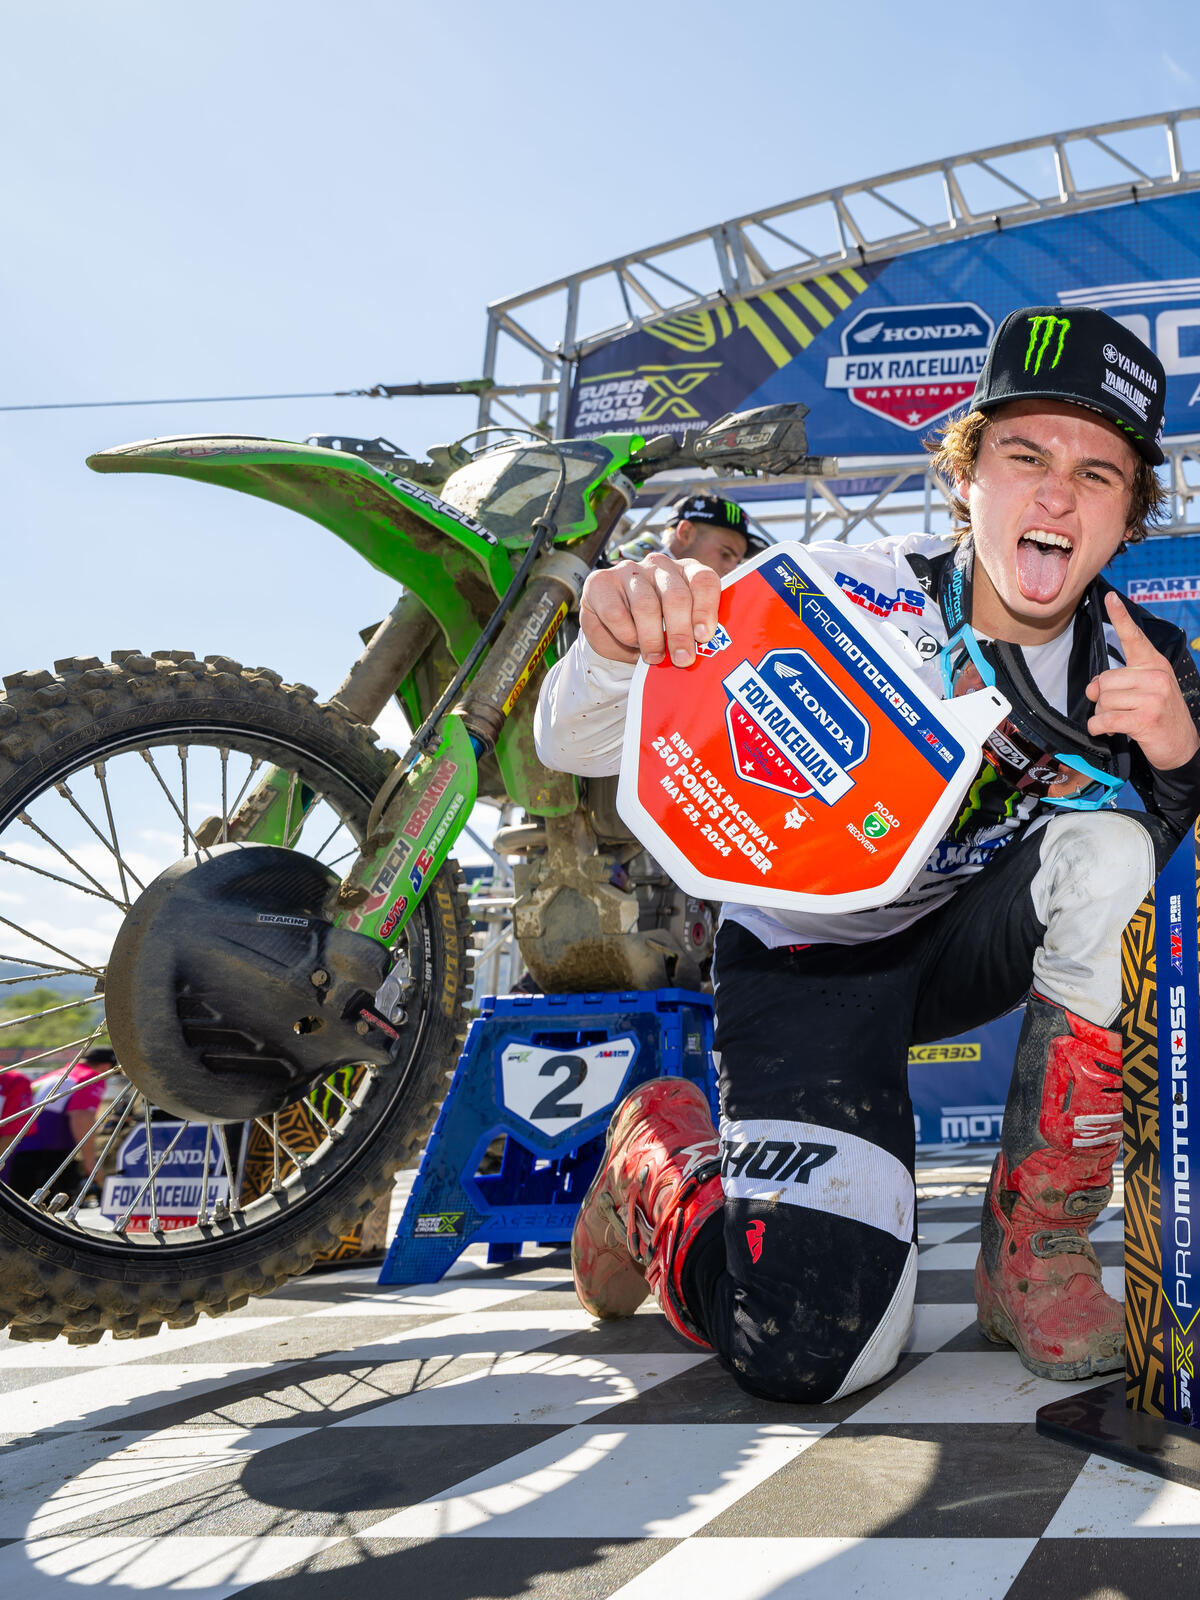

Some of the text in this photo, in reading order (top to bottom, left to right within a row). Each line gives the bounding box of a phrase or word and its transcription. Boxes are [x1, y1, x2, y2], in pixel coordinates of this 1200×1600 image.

[883, 323, 983, 342] HONDA
[579, 379, 649, 401] SUPER
[846, 355, 987, 381] FOX RACEWAY
[1105, 368, 1150, 412] YAMALUBE
[1118, 352, 1158, 395] YAMAHA
[580, 394, 644, 414] MOTO
[866, 386, 966, 399] NATIONAL
[575, 407, 644, 428] CROSS
[775, 565, 806, 596] SMX
[834, 571, 925, 610] PARS
[527, 610, 565, 673] SHOWA
[805, 599, 921, 727] PROMOTOCROSS
[739, 677, 837, 787] FOX RACEWAY
[789, 679, 854, 756] HONDA
[737, 714, 799, 786] NATIONAL
[917, 729, 942, 751] AMA
[403, 759, 458, 840] BRAKING
[652, 736, 774, 875] 250 POINTS LEADER
[669, 732, 779, 854] RND 1: FOX RACEWAY
[874, 801, 900, 828] ROAD
[429, 792, 465, 855] PISTONS
[660, 776, 733, 857] MAY 25, 2024
[846, 823, 878, 854] RECOVERY
[866, 821, 880, 835] 2
[408, 848, 434, 894] JE
[257, 914, 308, 927] BRAKING
[380, 896, 408, 940] GUTS
[1169, 895, 1177, 922] PRO
[1170, 923, 1183, 976] AMA
[529, 1055, 588, 1120] 2
[145, 1150, 217, 1165] HONDA
[721, 1140, 838, 1184] HOR
[1170, 985, 1193, 1309] PROMOTOCROSS
